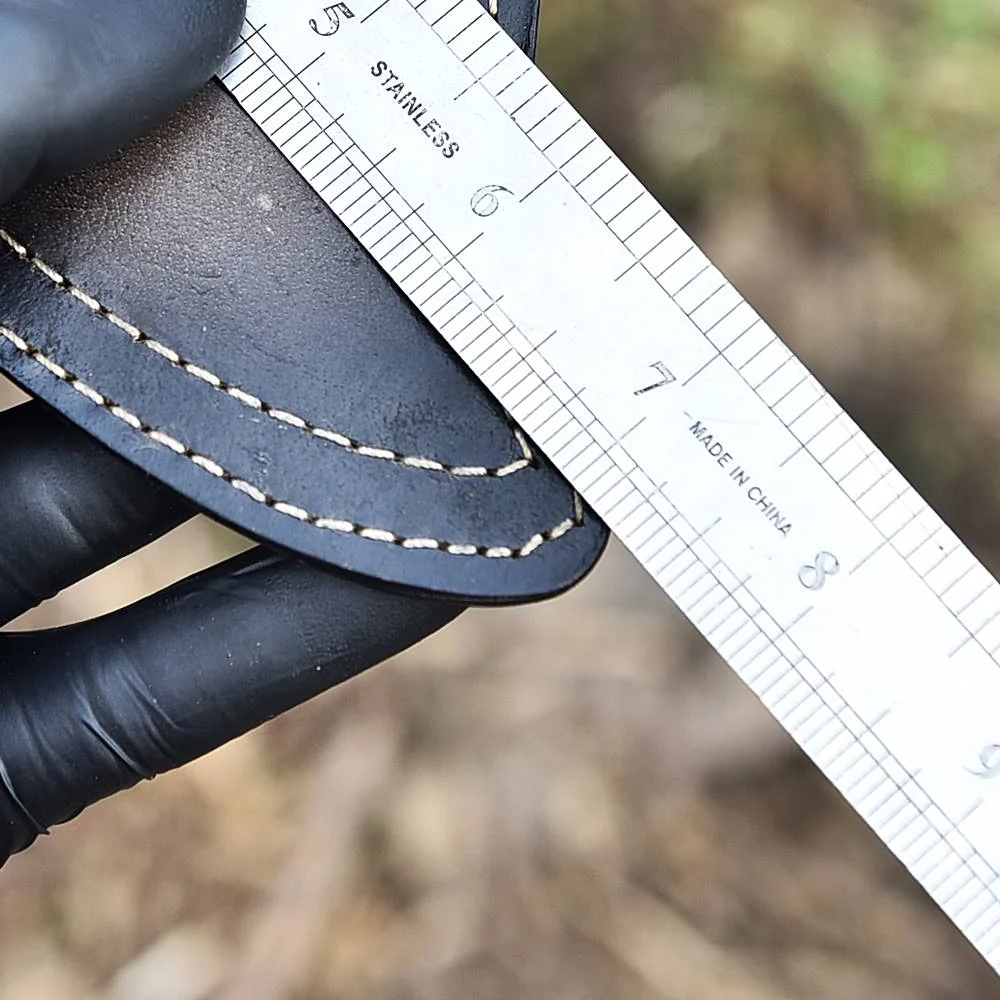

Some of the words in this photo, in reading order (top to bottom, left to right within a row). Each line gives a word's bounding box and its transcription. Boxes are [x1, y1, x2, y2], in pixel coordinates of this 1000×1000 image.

[308, 1, 356, 37] 5
[370, 60, 460, 159] STAINLESS
[470, 184, 515, 217] 6
[633, 360, 677, 396] 7
[688, 420, 733, 468] MADE
[728, 466, 751, 487] IN
[747, 486, 792, 537] CHINA
[797, 550, 840, 591] 8
